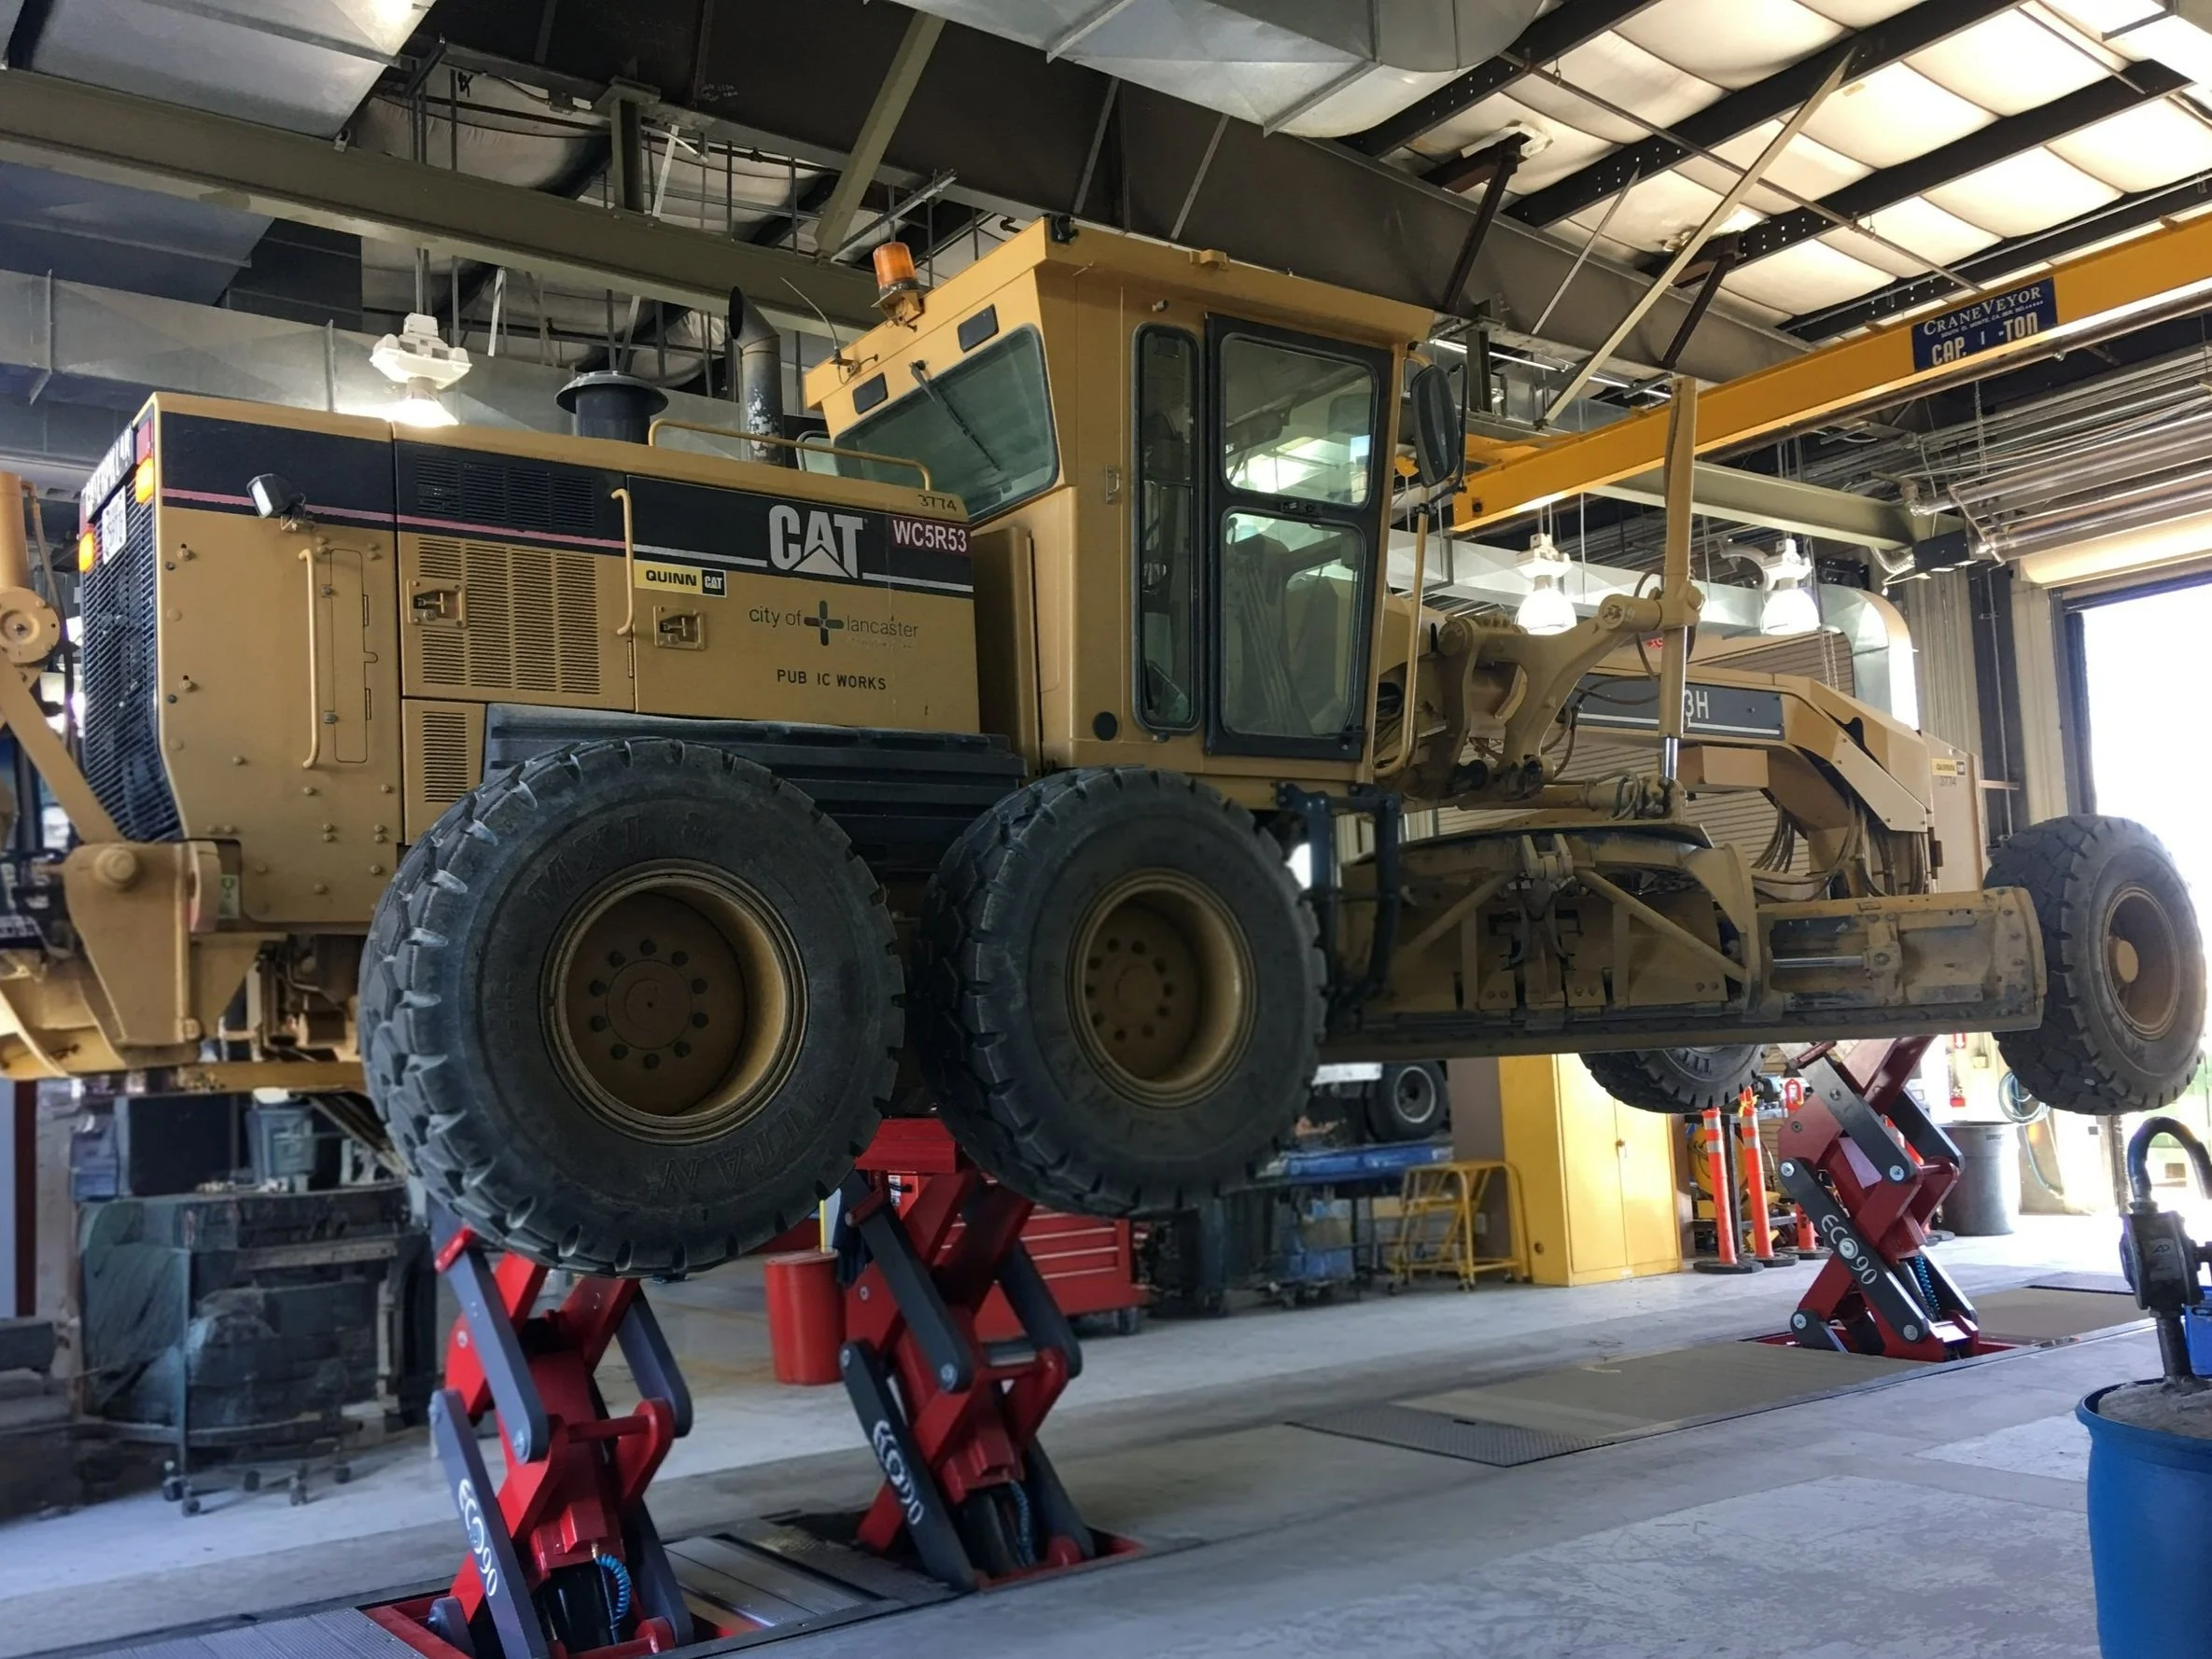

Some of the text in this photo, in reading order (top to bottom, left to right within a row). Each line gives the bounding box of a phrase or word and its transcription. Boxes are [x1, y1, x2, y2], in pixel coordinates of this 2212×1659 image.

[1932, 337, 1967, 365] CAP.
[917, 494, 958, 511] 3774
[769, 504, 863, 579] CAT
[892, 520, 967, 553] WC5R53
[645, 568, 722, 590] QUINN CAT
[749, 606, 919, 637] city of lancaster
[836, 674, 887, 690] WORKS
[1821, 1214, 1878, 1285] ECO90
